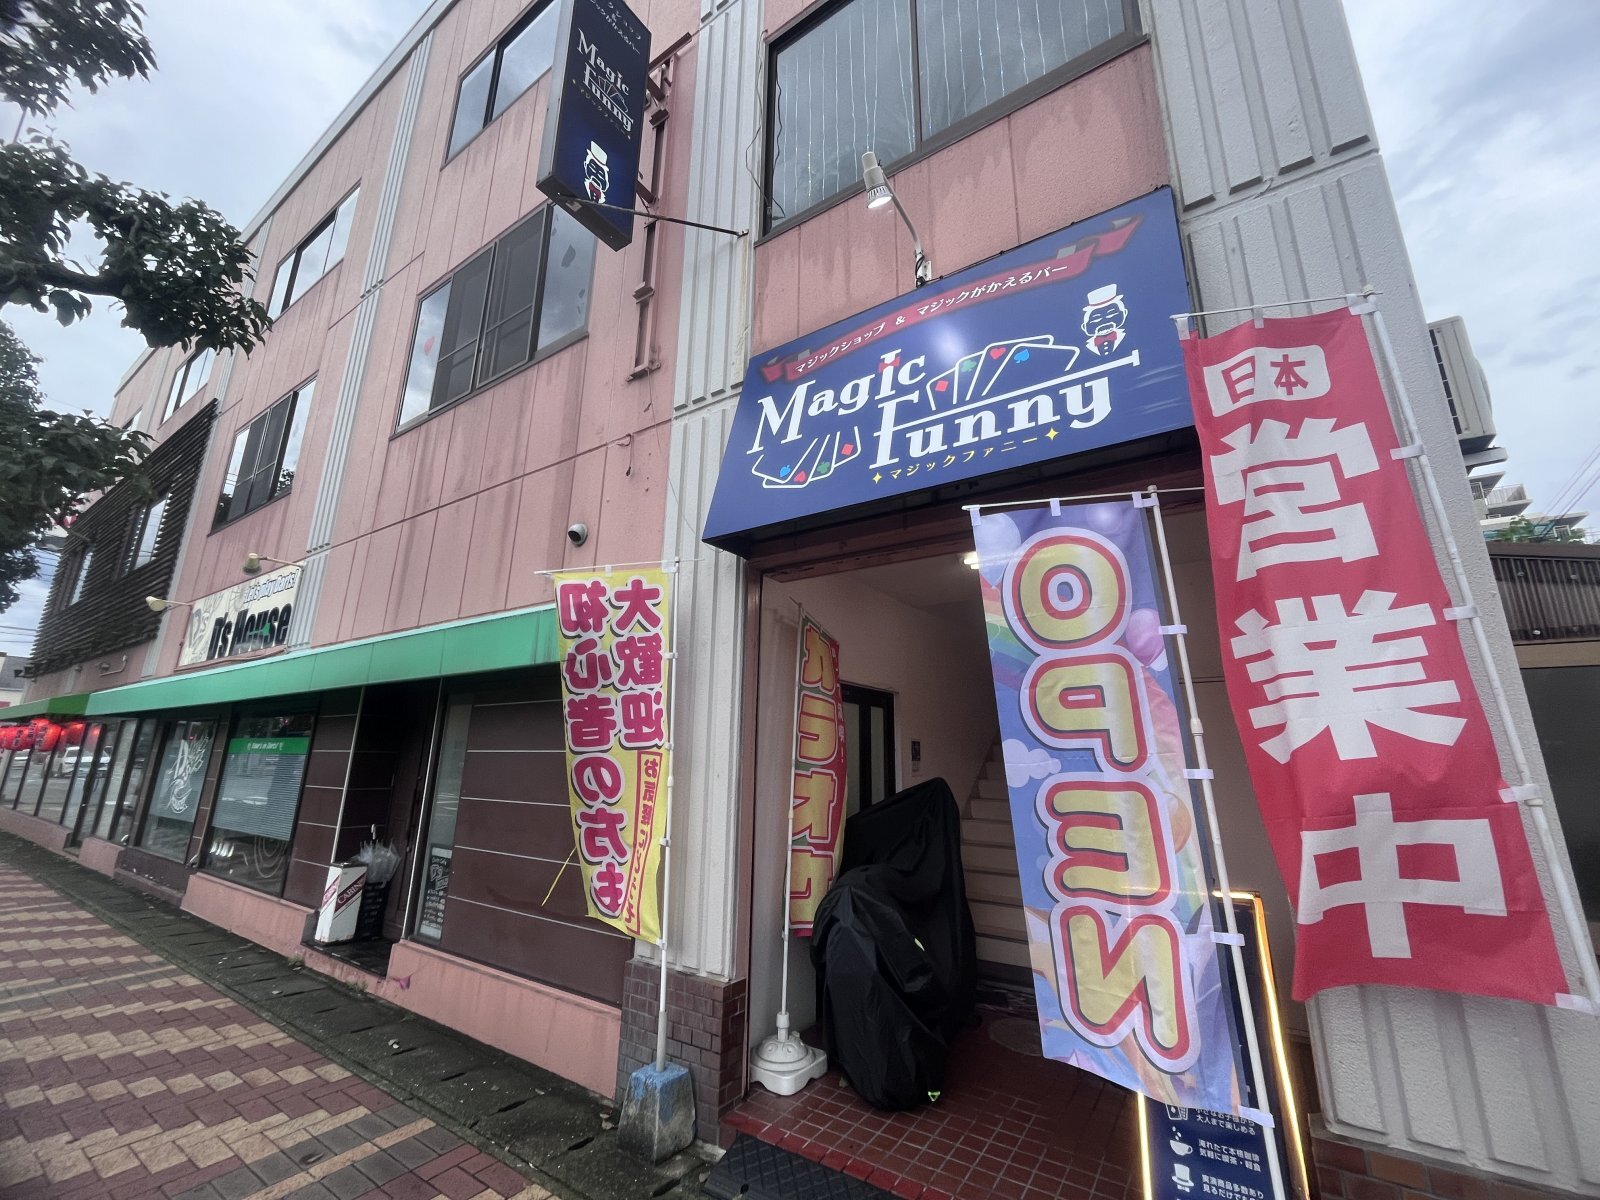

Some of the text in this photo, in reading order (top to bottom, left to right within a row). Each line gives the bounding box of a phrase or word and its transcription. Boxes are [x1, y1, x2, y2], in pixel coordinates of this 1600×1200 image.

[577, 27, 630, 96] Magic
[583, 62, 634, 132] Funny
[796, 265, 1069, 372] マジックショップ & マジックがかえるバー
[746, 349, 928, 455] Magic
[869, 354, 1140, 471] Funny
[890, 436, 1038, 481] マジックファニー
[228, 603, 292, 655] House
